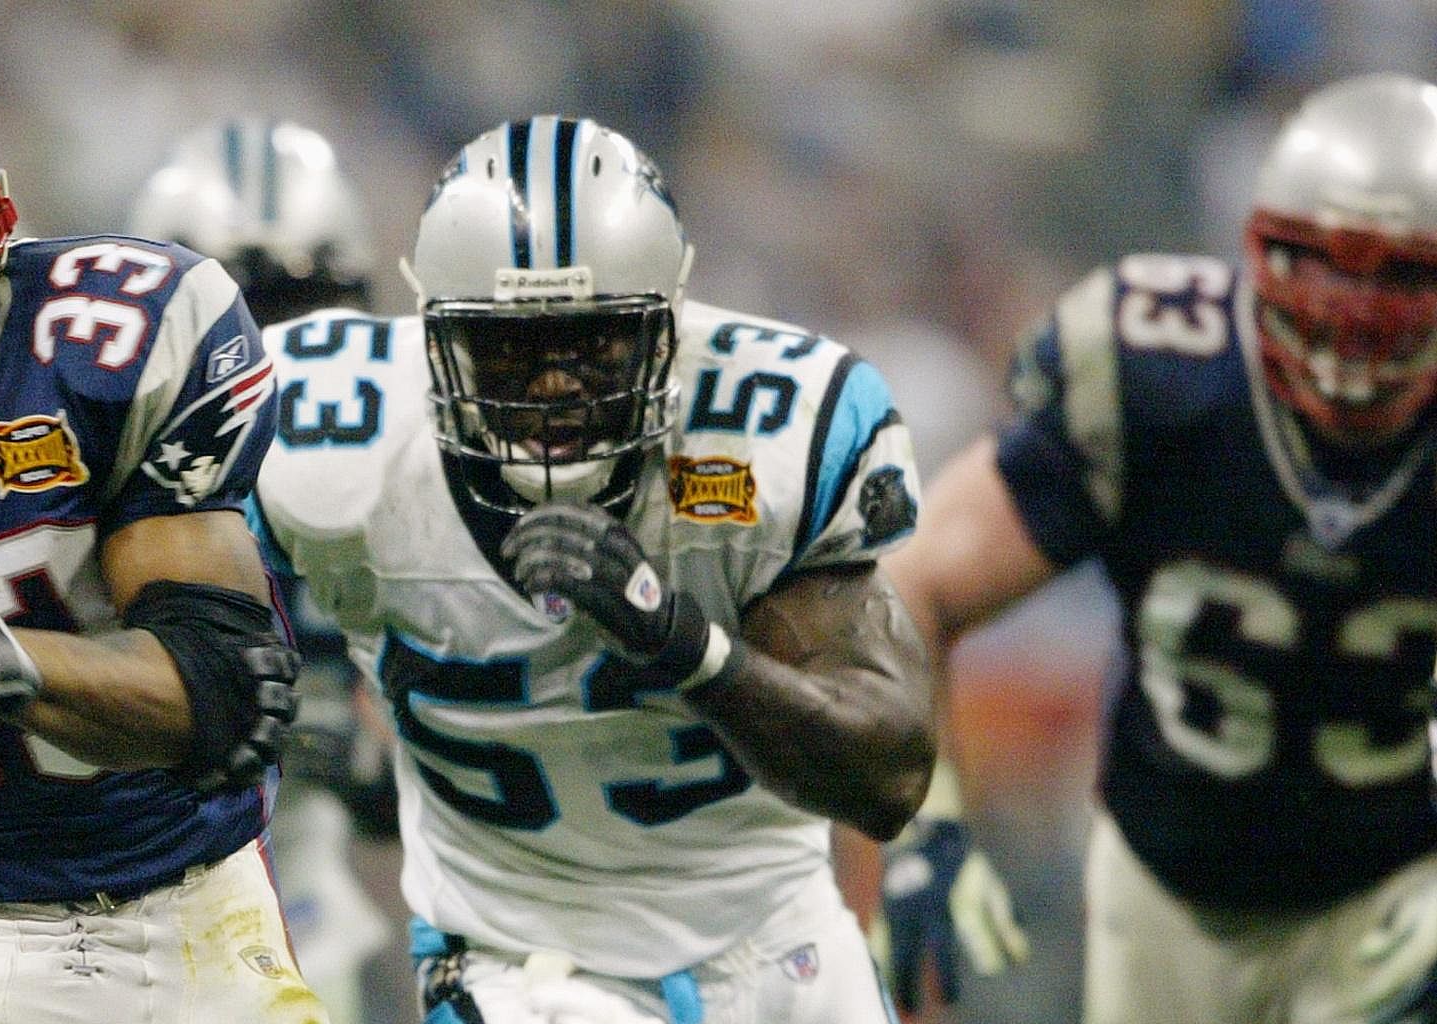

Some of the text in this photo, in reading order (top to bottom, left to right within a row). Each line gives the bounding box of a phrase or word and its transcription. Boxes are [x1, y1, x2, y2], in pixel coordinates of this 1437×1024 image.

[31, 242, 174, 372] 33
[277, 317, 396, 450] 53
[684, 320, 822, 438] 53
[376, 625, 757, 835] 53
